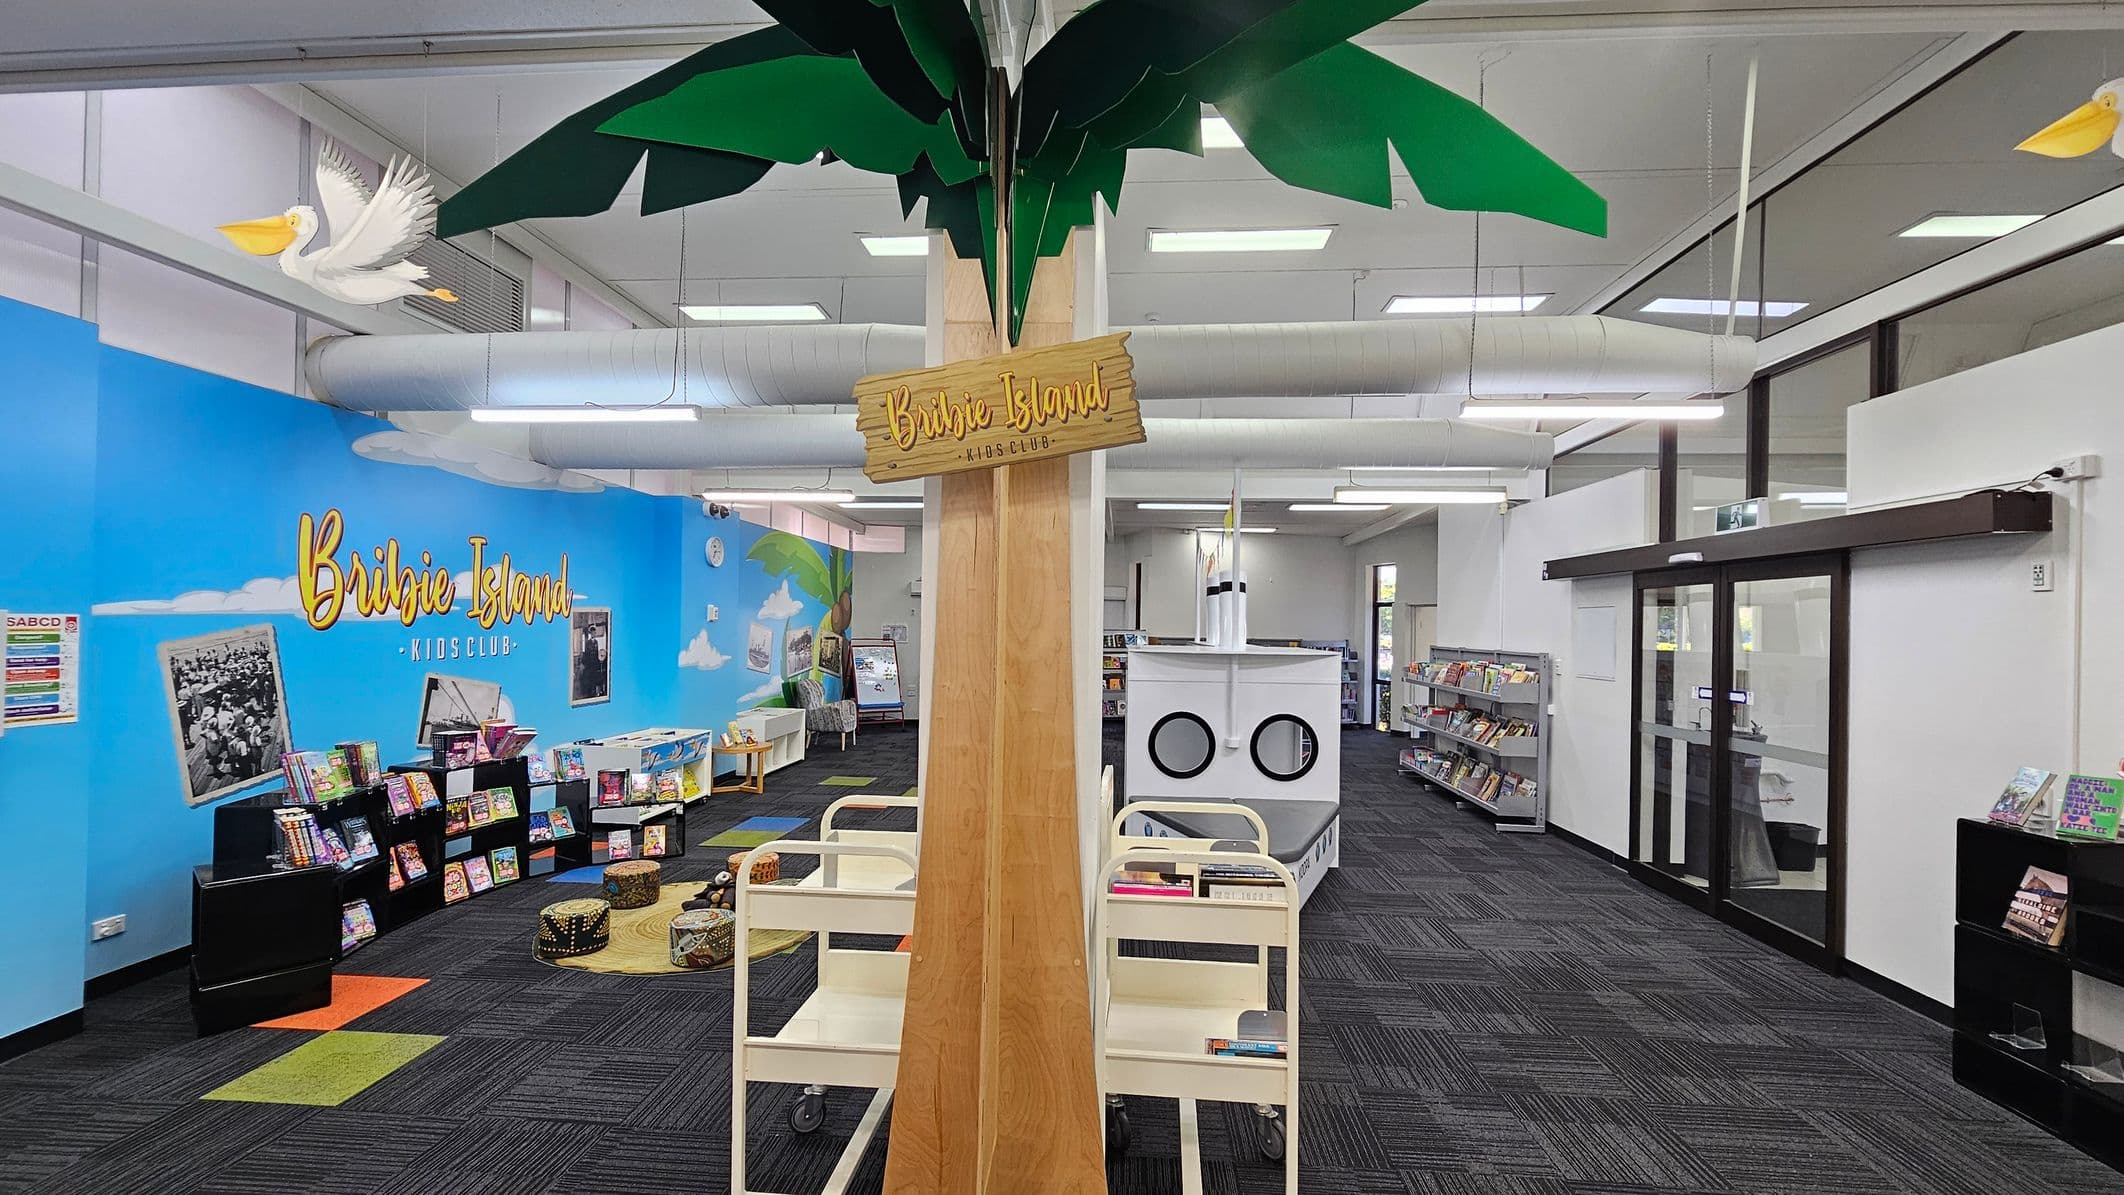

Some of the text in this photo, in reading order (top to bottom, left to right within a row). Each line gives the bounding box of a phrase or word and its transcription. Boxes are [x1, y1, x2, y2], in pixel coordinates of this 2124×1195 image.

[886, 360, 1109, 451] Bribie Island
[966, 434, 1050, 462] KIDS CLUB
[298, 508, 573, 631] Bribie Island
[7, 617, 60, 627] SABCD
[411, 635, 511, 662] KIDS CLUB
